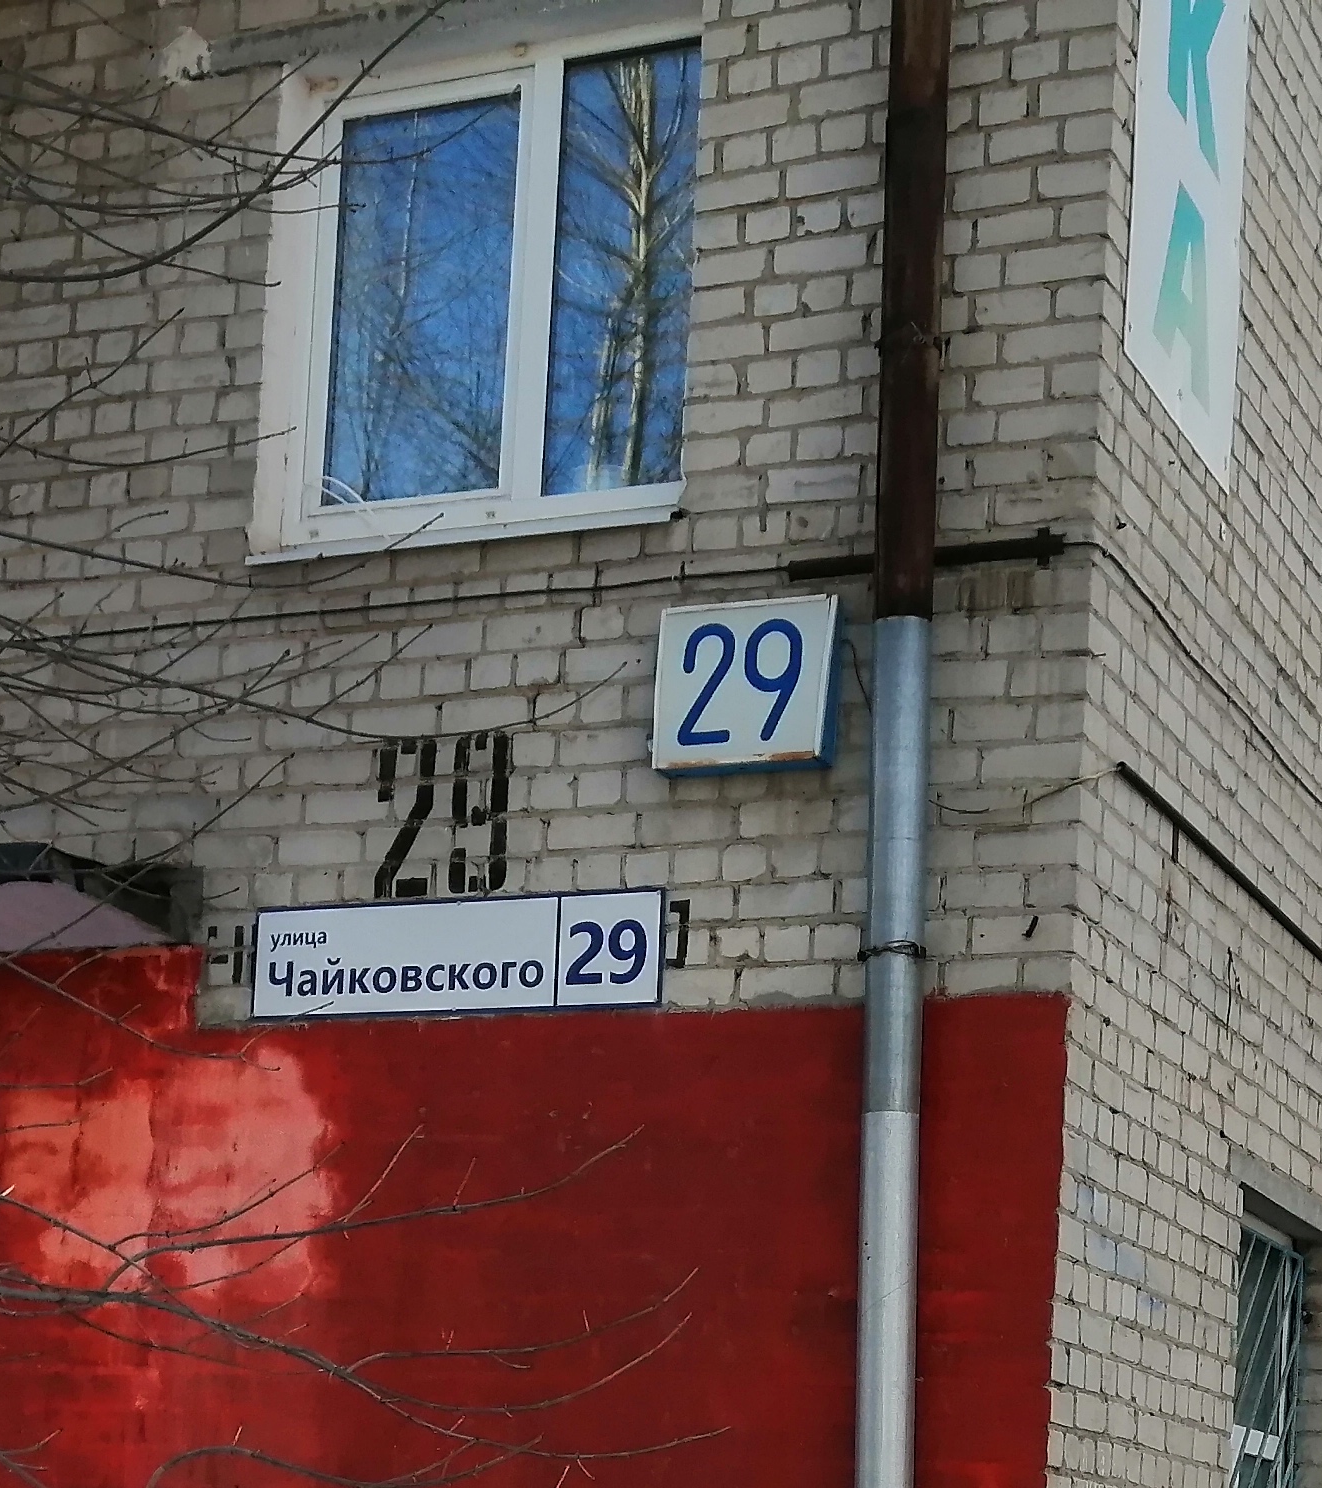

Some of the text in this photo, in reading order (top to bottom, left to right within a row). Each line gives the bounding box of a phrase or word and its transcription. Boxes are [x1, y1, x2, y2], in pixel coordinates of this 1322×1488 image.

[677, 619, 803, 746] 29
[374, 730, 509, 898] 29
[270, 928, 327, 951] улица
[565, 919, 648, 986] 29
[268, 957, 544, 997] Чайковского
